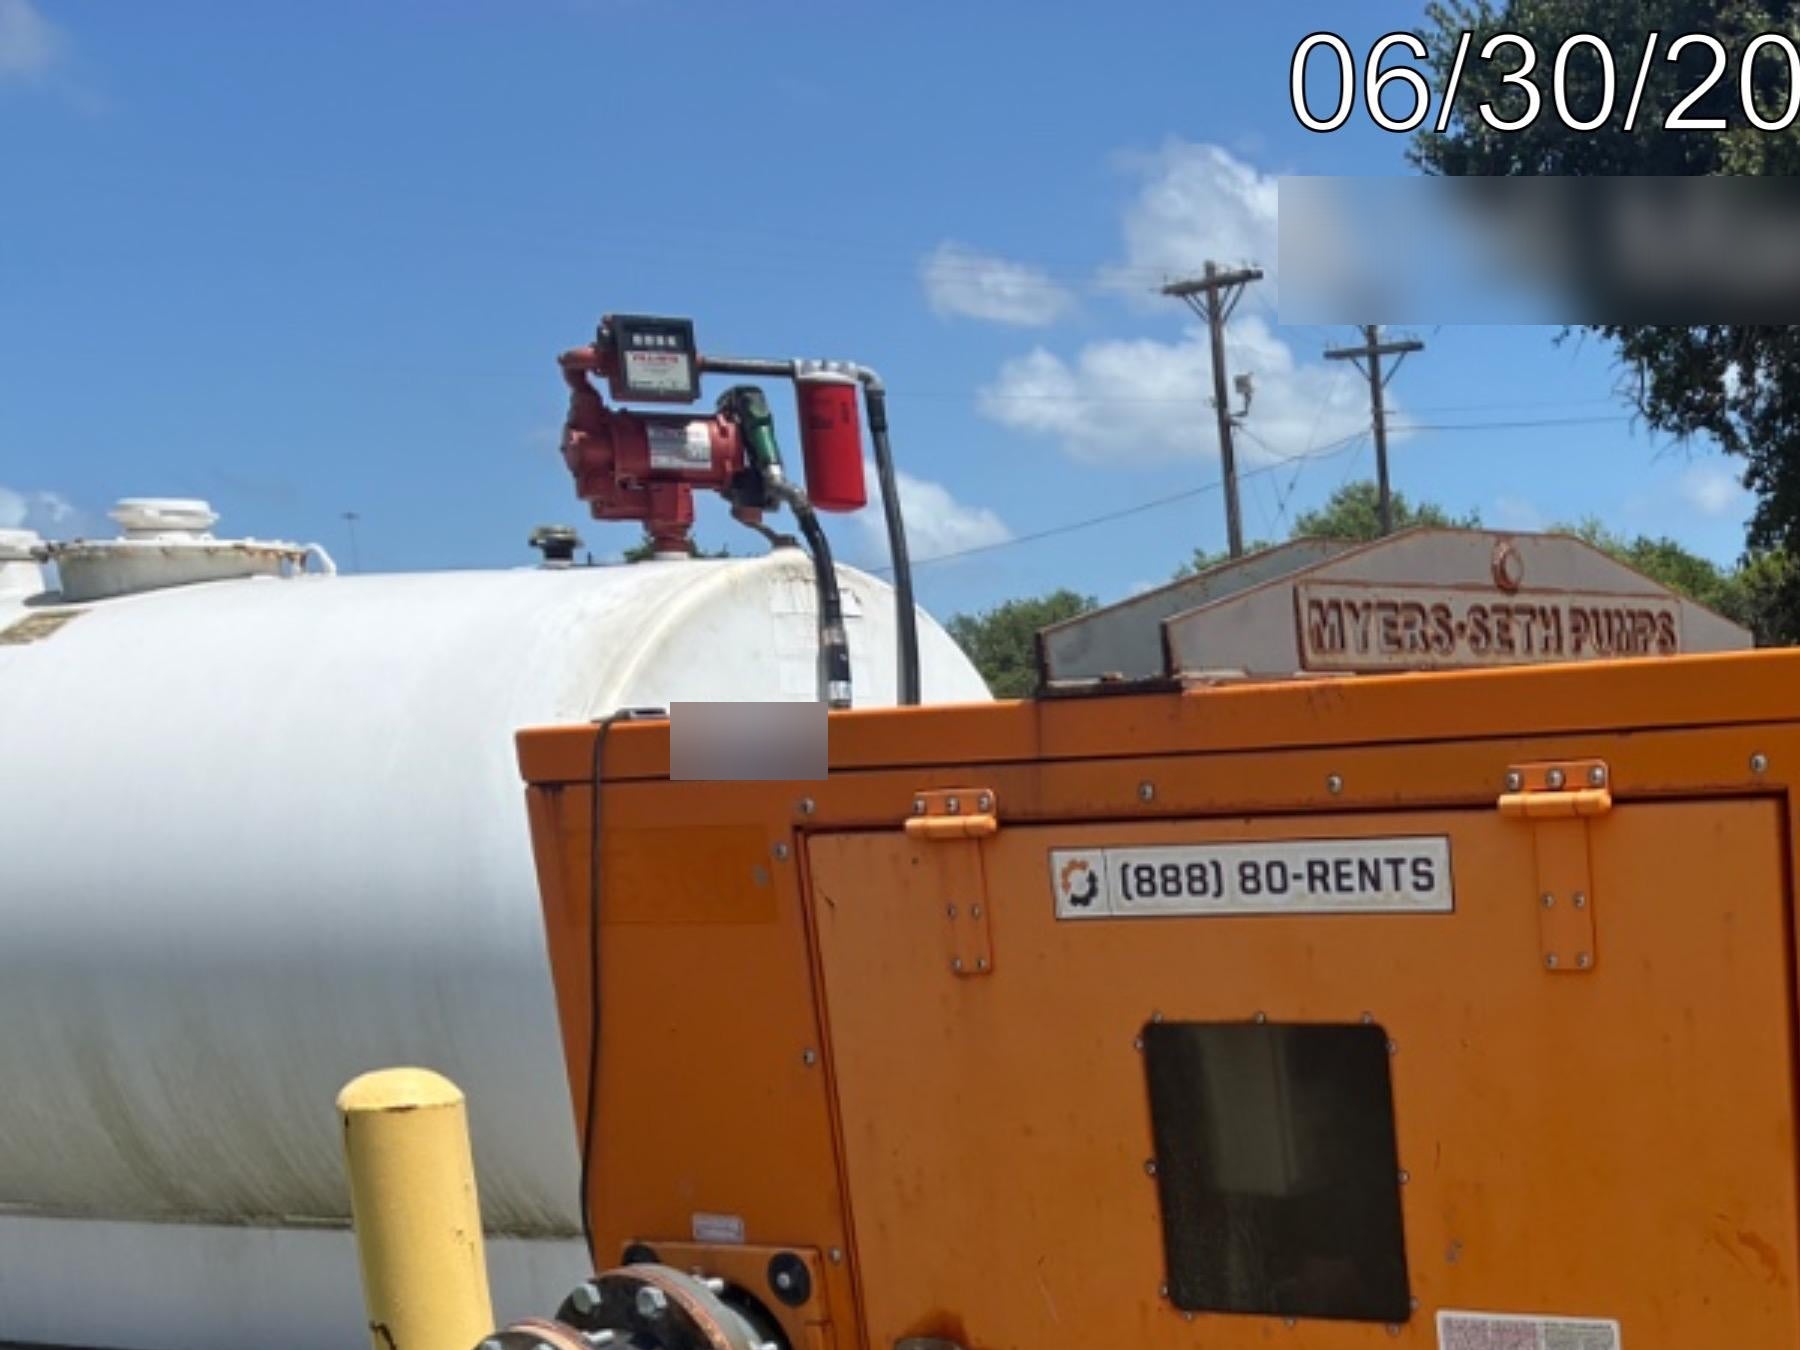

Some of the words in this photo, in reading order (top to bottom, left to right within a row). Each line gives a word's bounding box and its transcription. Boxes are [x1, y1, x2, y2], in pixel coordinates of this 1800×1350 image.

[1570, 606, 1676, 656] PUMPS
[1121, 861, 1224, 899] (888)
[1239, 857, 1436, 896] 80-RENTS
